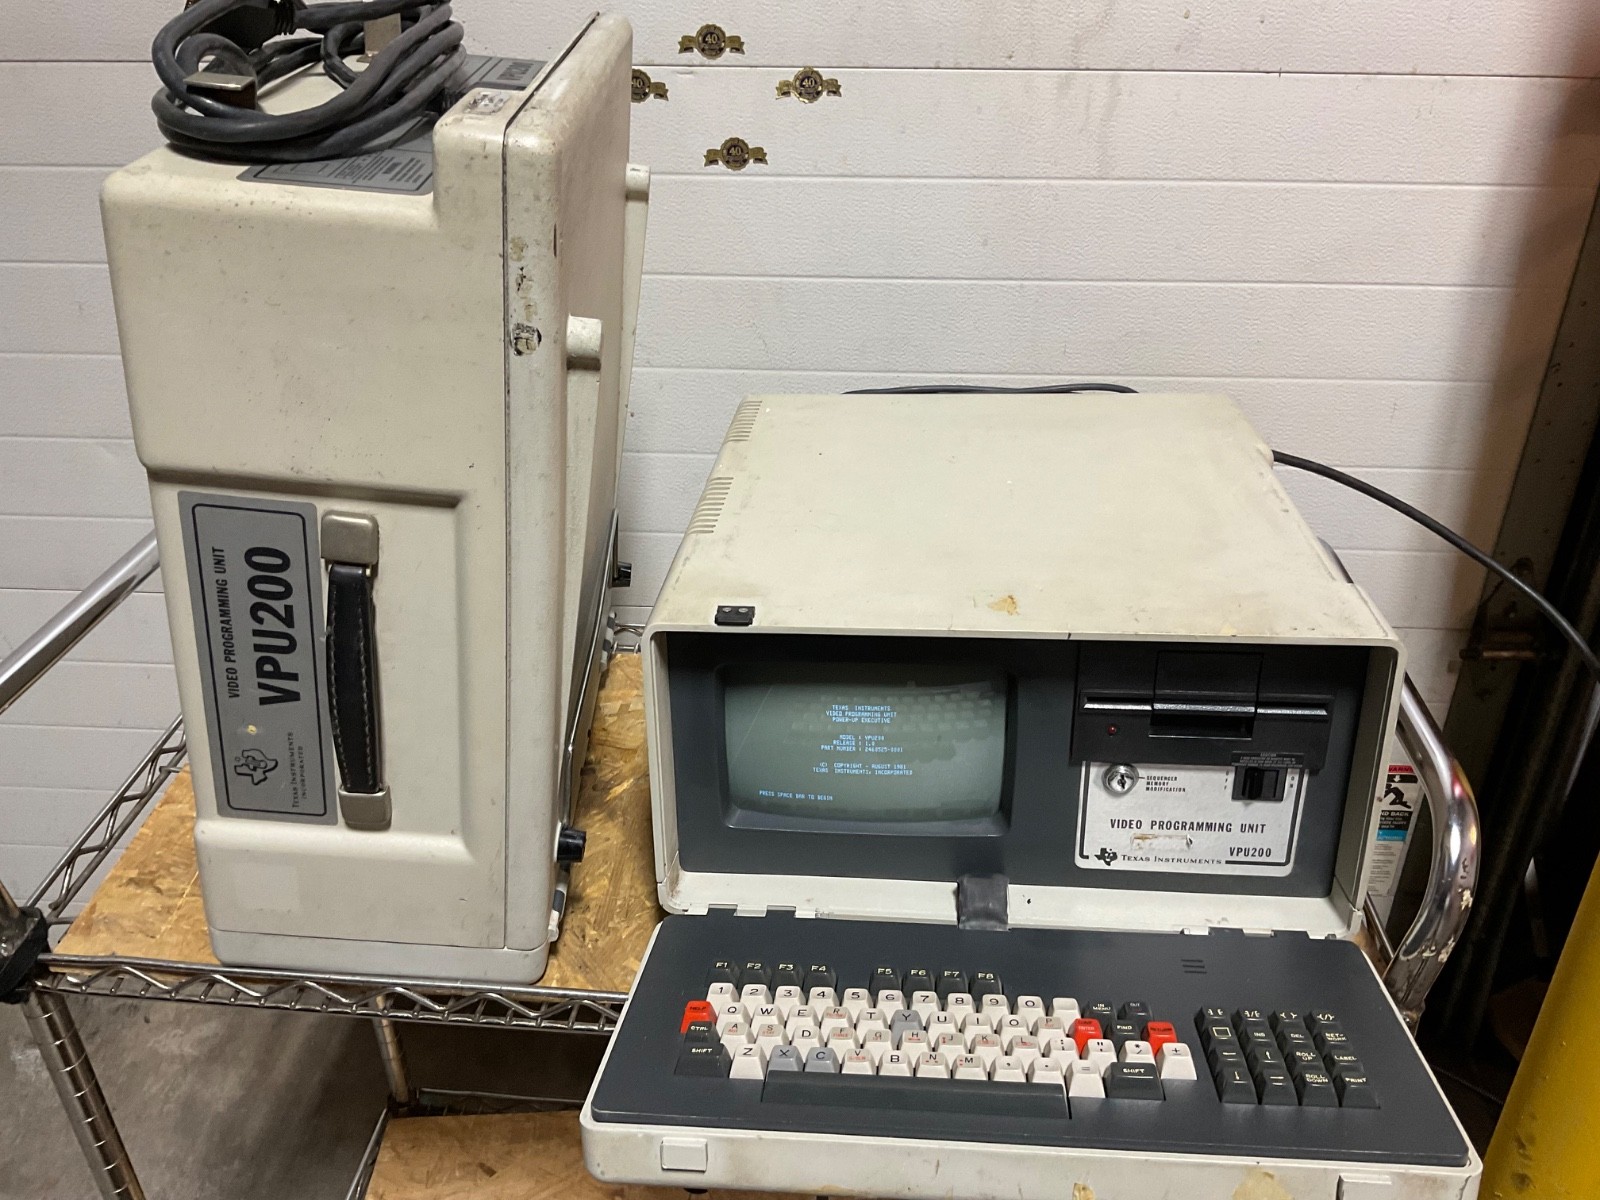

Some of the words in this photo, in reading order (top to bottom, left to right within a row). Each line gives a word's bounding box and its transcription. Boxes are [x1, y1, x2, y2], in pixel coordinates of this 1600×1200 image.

[705, 33, 718, 43] 40
[802, 78, 815, 87] 40
[729, 146, 741, 156] 40
[211, 546, 227, 575] UNIT
[215, 579, 238, 663] PROGRAMMING
[244, 546, 301, 706] VPU200
[228, 664, 240, 698] VIDEO
[1110, 818, 1143, 830] VIDEO
[1150, 820, 1233, 833] PROGRAMMING
[1240, 823, 1267, 834] UNIT
[1229, 846, 1272, 858] VPU200
[1121, 854, 1150, 862] TEXAS
[1154, 855, 1223, 865] INSTRUMENTS
[885, 993, 895, 1001] 6
[802, 1030, 811, 1038] D
[780, 1049, 790, 1057] X
[816, 1051, 826, 1059] C
[890, 1055, 900, 1063] B
